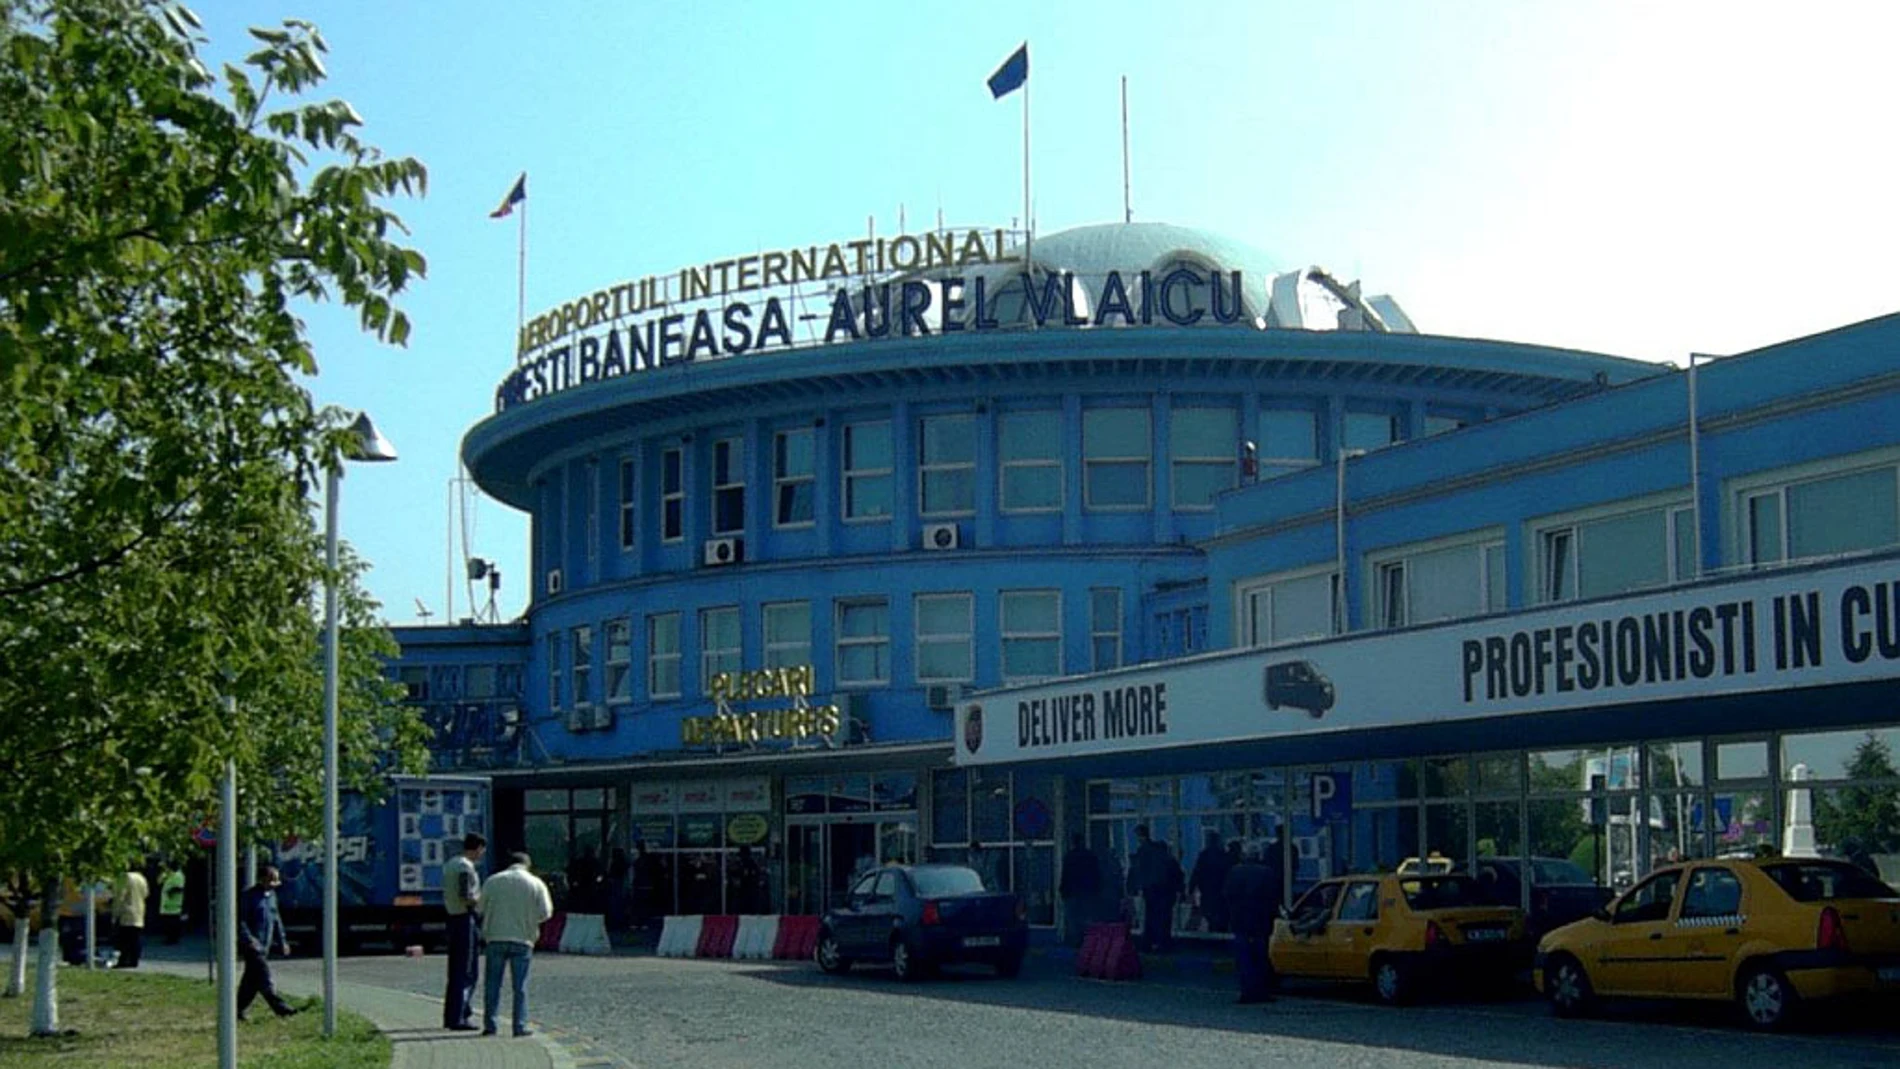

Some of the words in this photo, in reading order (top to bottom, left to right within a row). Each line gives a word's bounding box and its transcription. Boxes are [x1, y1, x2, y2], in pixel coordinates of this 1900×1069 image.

[681, 229, 1020, 302] INTERNATIONAL
[580, 297, 791, 382] BANEASA
[825, 275, 998, 342] AUREL
[1021, 269, 1243, 327] VLAICU
[1462, 600, 1756, 702] PROFESIONISTI
[1773, 591, 1821, 670] IN
[1018, 692, 1096, 748] DELIVER
[1103, 683, 1167, 739] MORE
[1313, 775, 1336, 818] P
